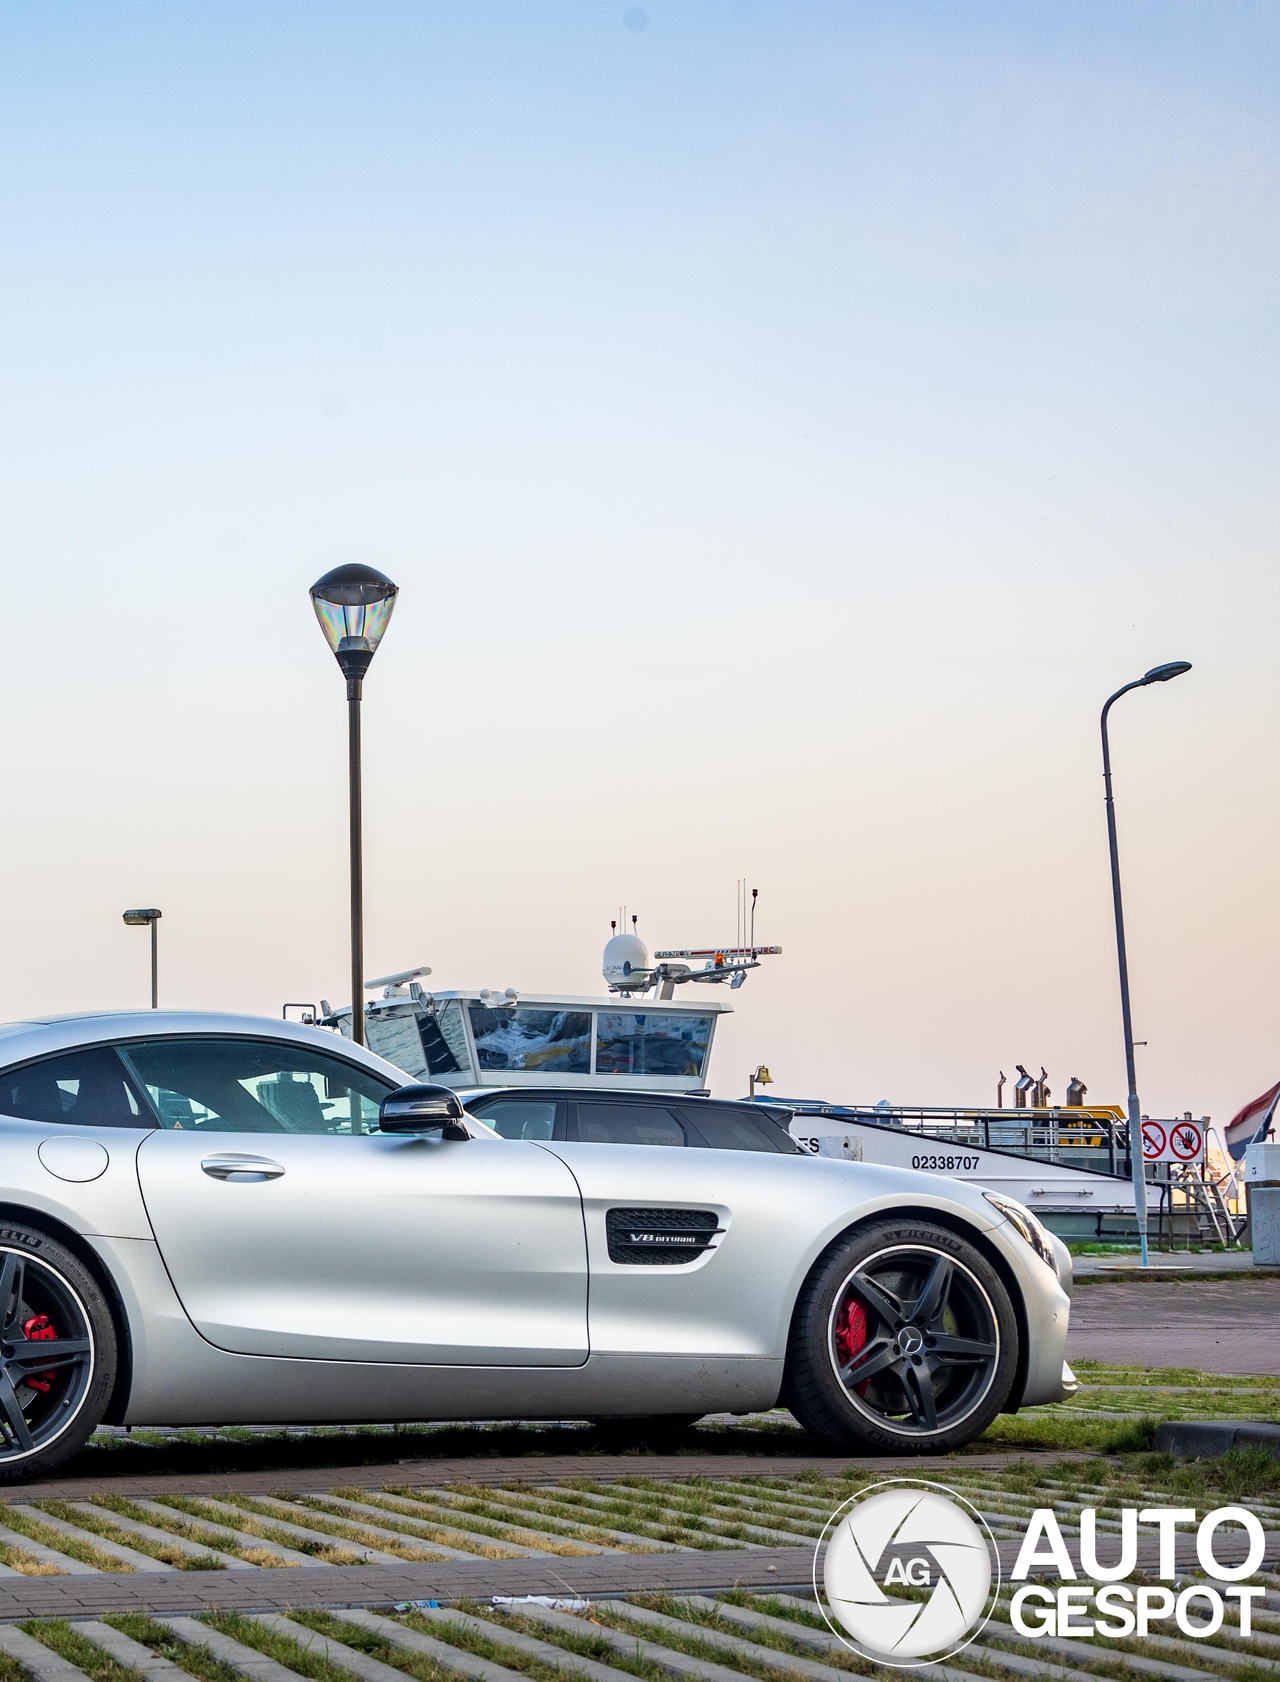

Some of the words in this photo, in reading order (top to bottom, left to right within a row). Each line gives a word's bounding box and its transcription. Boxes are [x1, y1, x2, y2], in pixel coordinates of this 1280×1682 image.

[758, 946, 775, 954] JRC
[911, 1155, 980, 1171] 02338707
[1251, 1166, 1258, 1176] 5
[630, 1233, 654, 1242] V8
[899, 1230, 959, 1249] MICHELIN
[45, 1245, 66, 1261] PILOT
[66, 1260, 86, 1282] SPORT
